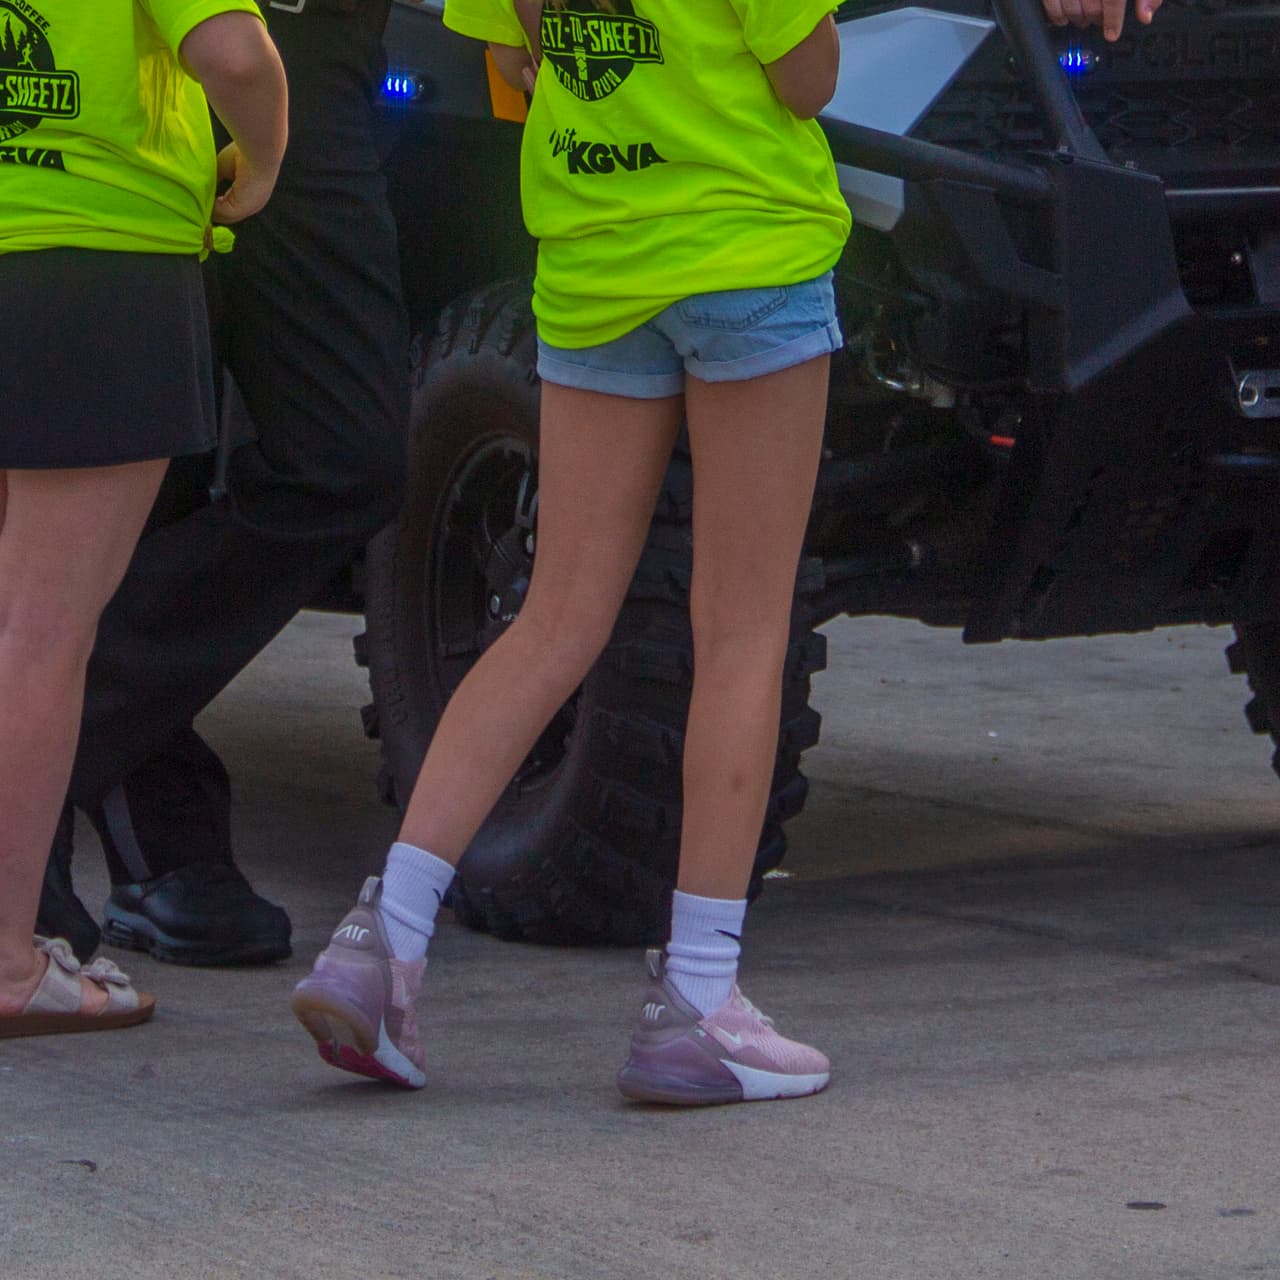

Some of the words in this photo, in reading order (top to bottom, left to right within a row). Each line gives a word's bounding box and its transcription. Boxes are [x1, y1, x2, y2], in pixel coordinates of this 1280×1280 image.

[556, 64, 590, 100] TRAIL
[593, 68, 622, 98] RUN
[567, 141, 670, 175] KGVA
